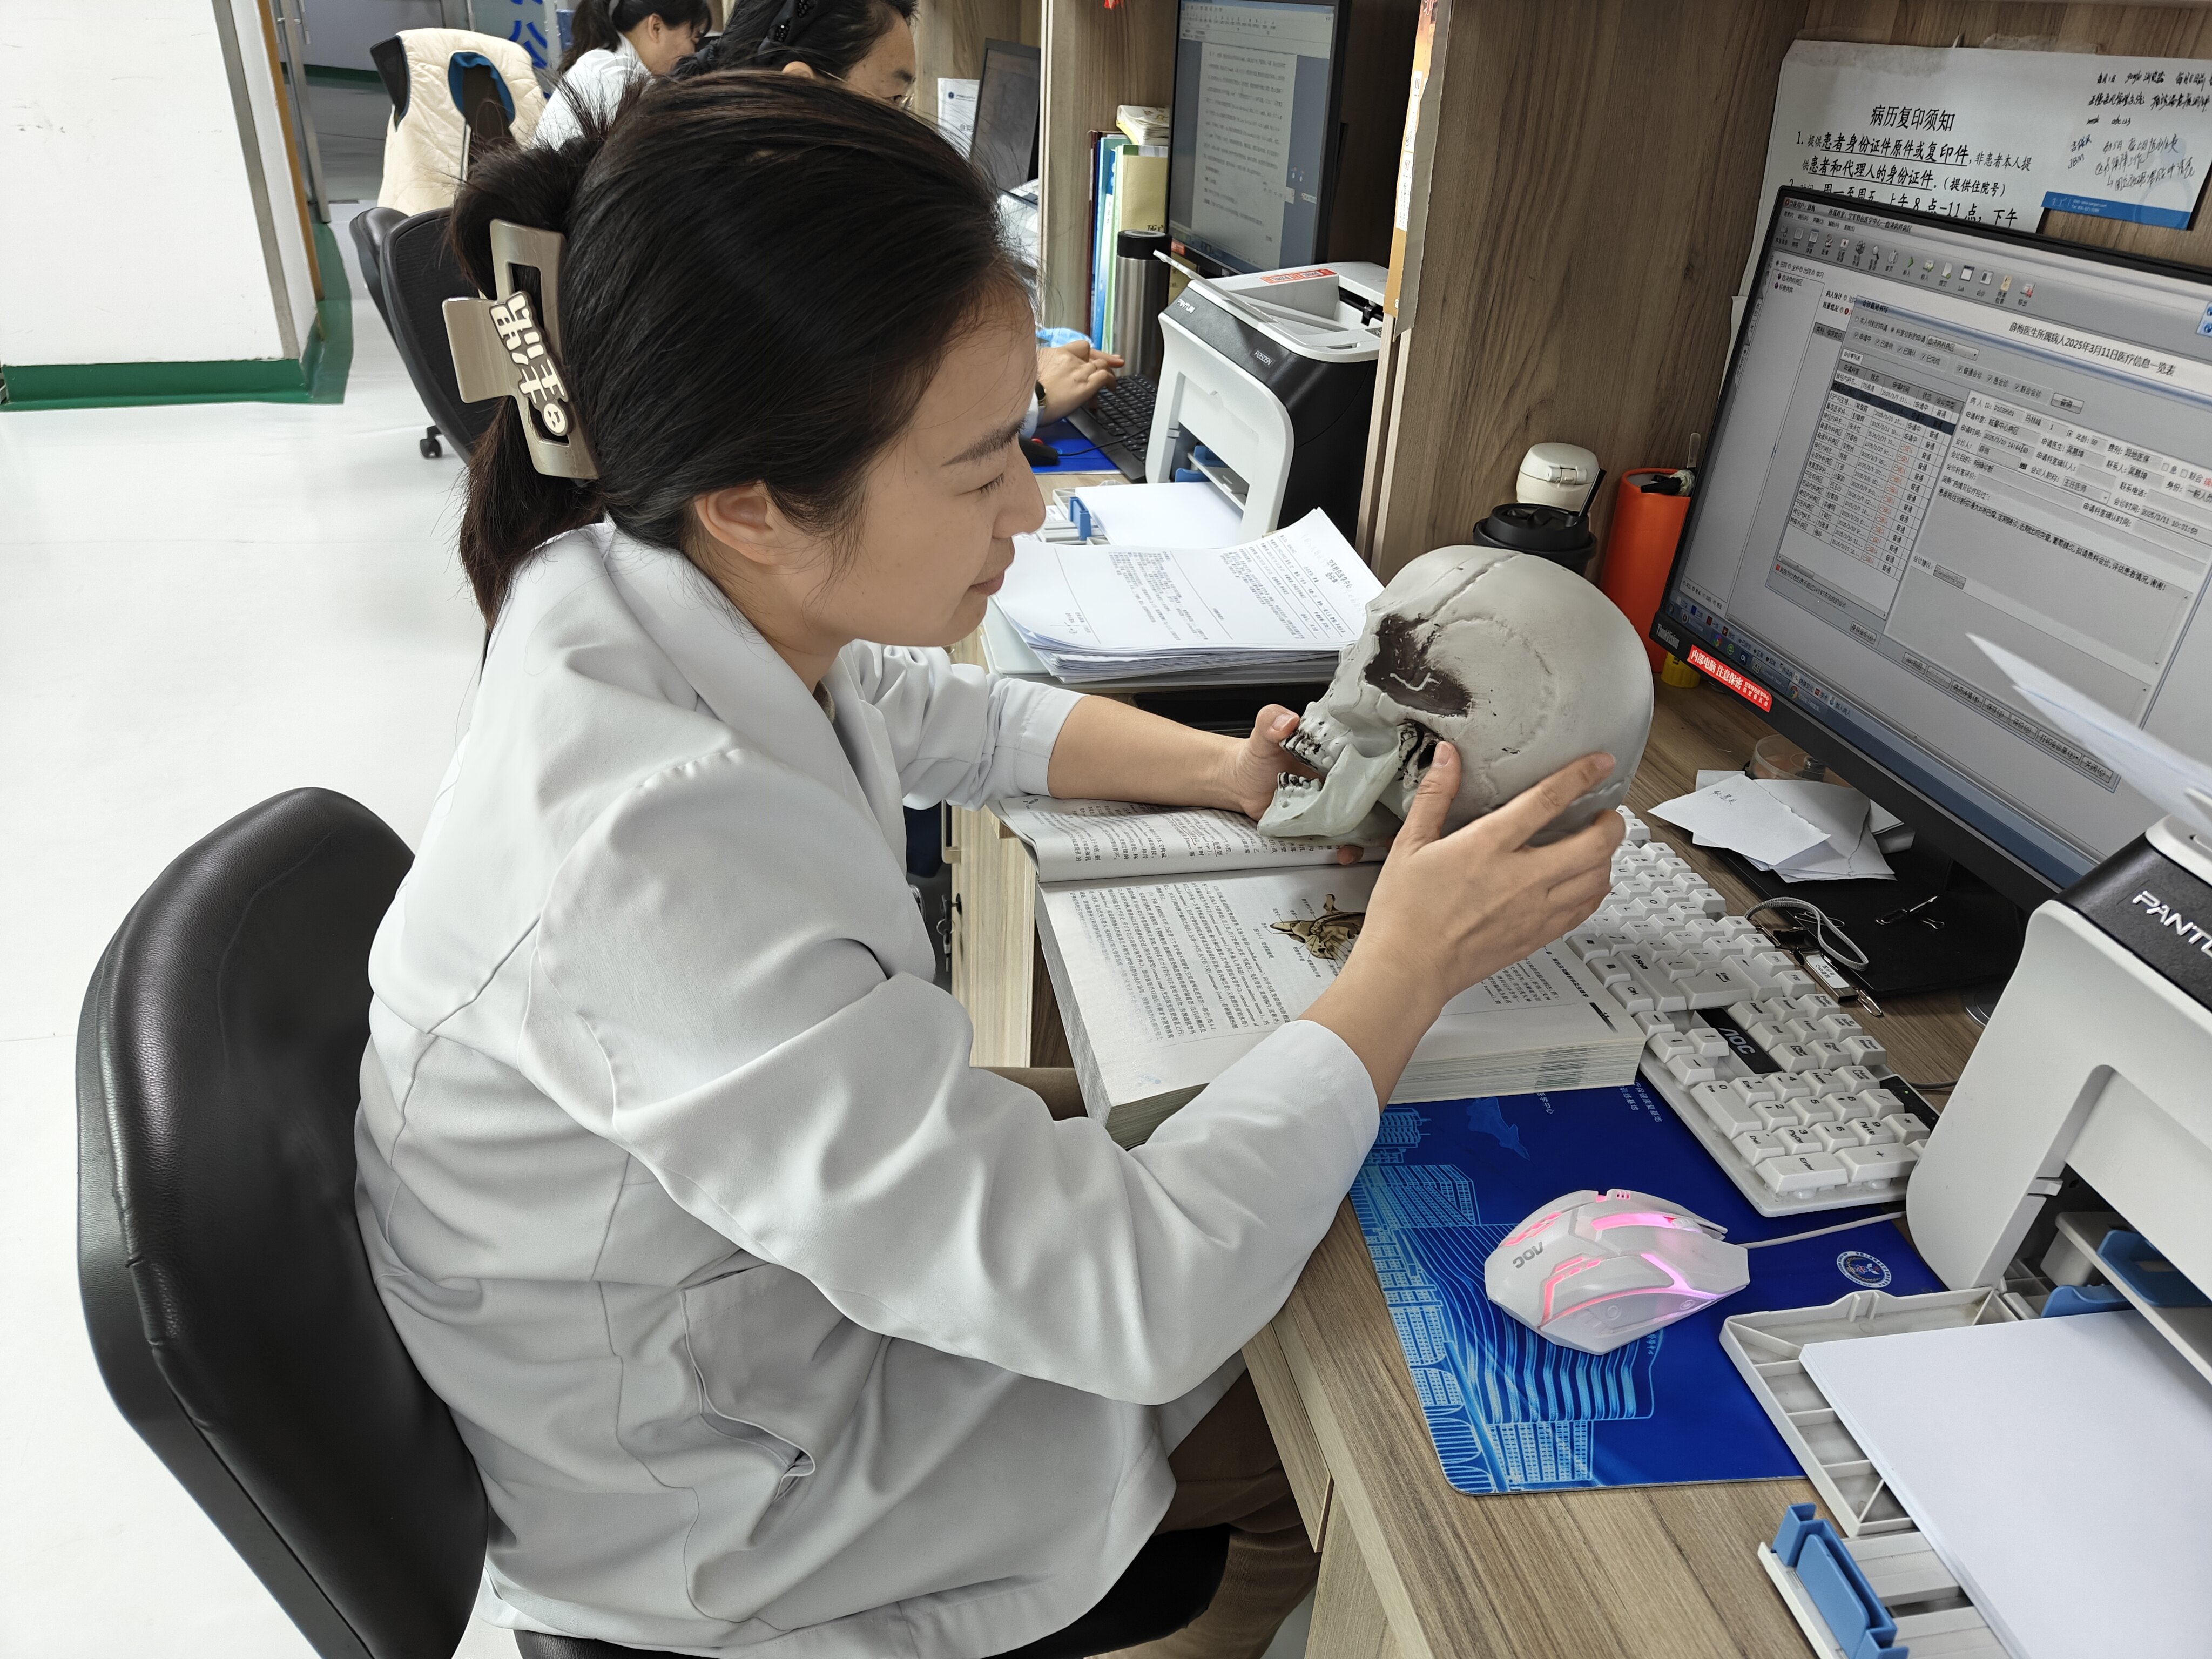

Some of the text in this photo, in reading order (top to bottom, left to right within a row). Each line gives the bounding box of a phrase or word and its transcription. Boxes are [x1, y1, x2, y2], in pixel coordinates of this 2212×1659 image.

[1870, 105, 1955, 132] 病历复印须知
[1858, 333, 1871, 343] 申请中
[1926, 354, 1940, 366] 已完成
[1843, 363, 1860, 376] 申请科室
[1870, 373, 1879, 383] 姓名
[1892, 381, 1910, 394] 申请时间
[1914, 400, 1928, 412] 申请中
[1936, 408, 1946, 419] 普通
[1907, 422, 1939, 440] 申请中 普通
[1903, 432, 1935, 450] 申请中 普通
[2064, 477, 2087, 494] 主任医师
[2188, 470, 2203, 485] 联合
[1690, 649, 1716, 674] 内部电脑
[1716, 665, 1743, 691] 注意保密
[1628, 987, 1640, 995] Ctrl
[1718, 1027, 1756, 1055] AOC
[1742, 1080, 1753, 1089] End
[1749, 1135, 1761, 1144] Del
[1799, 1157, 1815, 1171] Enter
[1513, 1242, 1543, 1269] AOC
